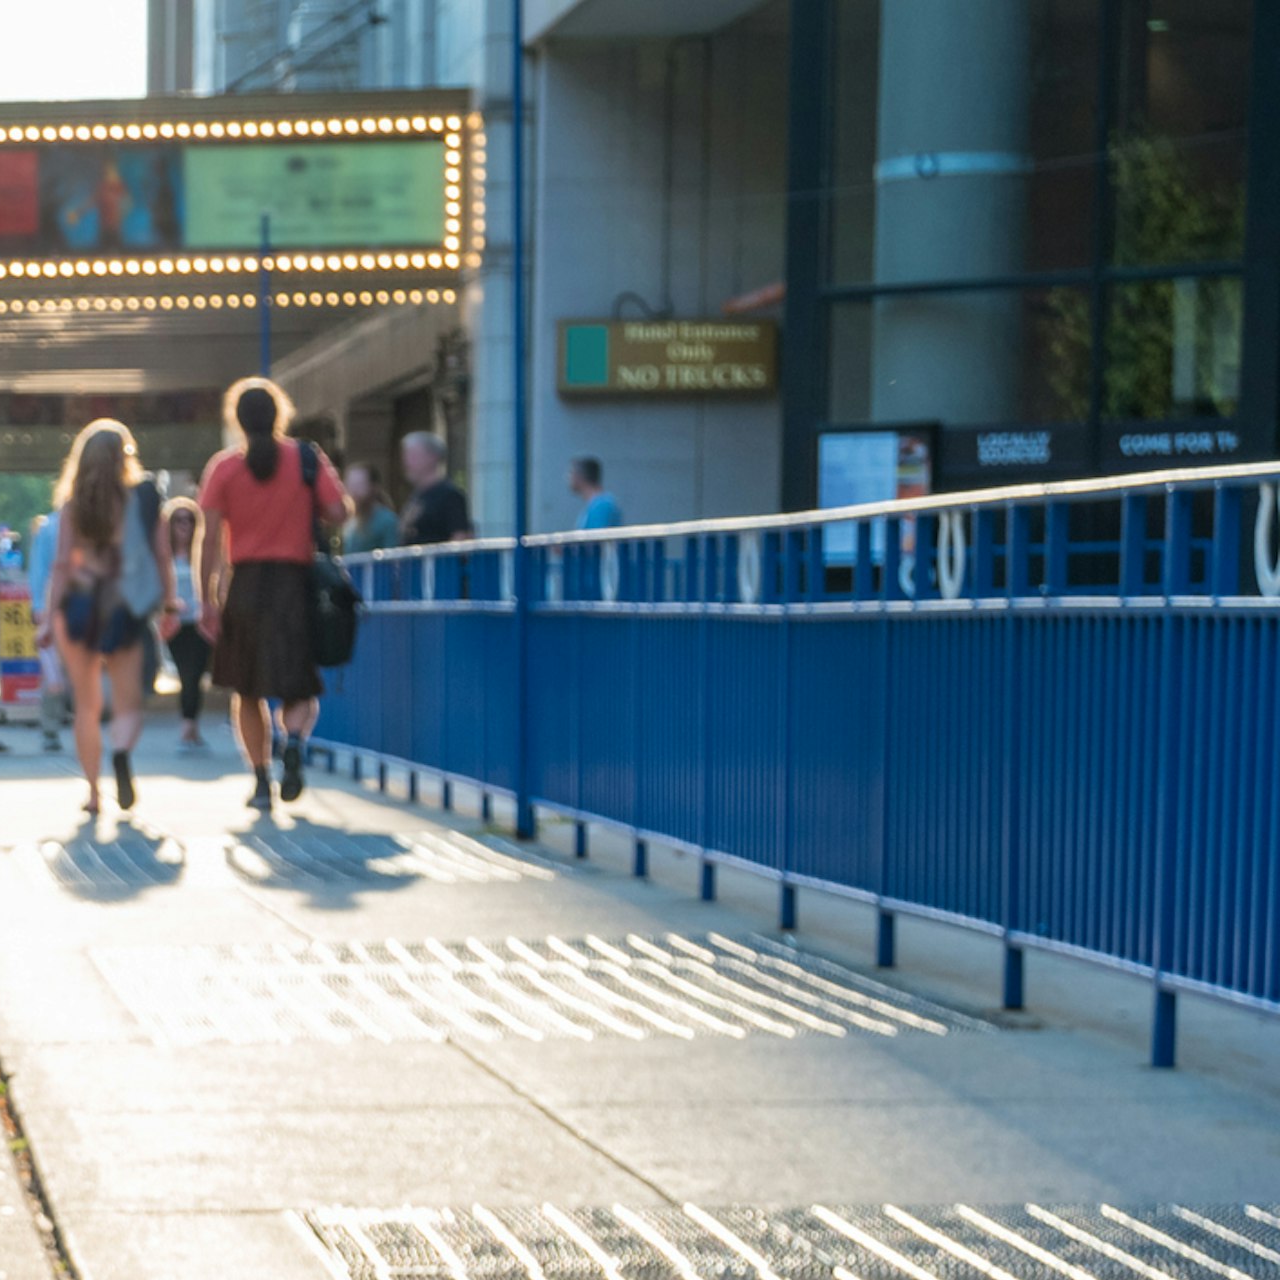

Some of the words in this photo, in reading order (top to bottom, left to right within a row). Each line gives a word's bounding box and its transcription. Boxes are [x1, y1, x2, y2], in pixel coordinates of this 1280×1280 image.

[618, 364, 660, 390] NO
[665, 364, 767, 389] TRUCKS
[1119, 433, 1171, 456] COME
[1174, 431, 1213, 455] FOR
